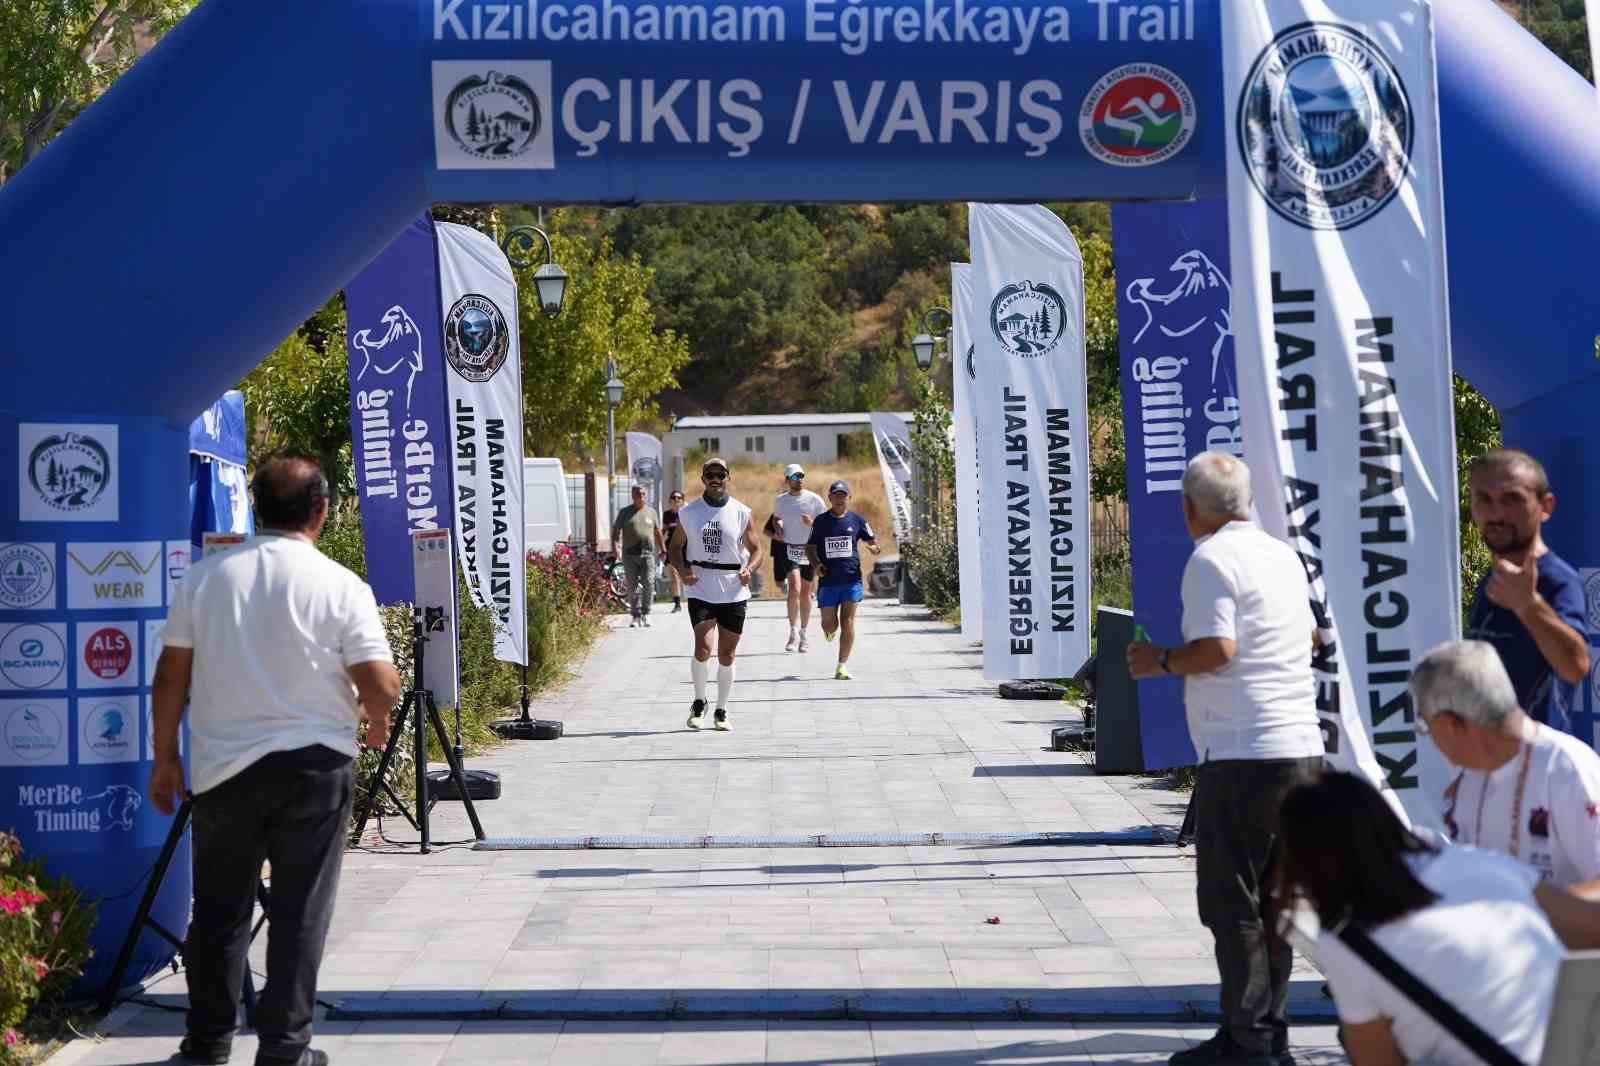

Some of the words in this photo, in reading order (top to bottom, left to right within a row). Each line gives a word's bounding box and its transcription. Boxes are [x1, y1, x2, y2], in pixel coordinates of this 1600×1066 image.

[432, 0, 786, 41] Kızılcahamam
[805, 0, 1070, 55] Eğrekkaya
[1088, 0, 1195, 41] Trail
[561, 77, 764, 157] ÇIKIŞ
[833, 79, 1063, 157] VARIŞ
[702, 536, 722, 545] NEVER
[704, 544, 720, 554] ENDS
[94, 582, 144, 599] WEAR
[92, 634, 125, 650] ALS
[18, 784, 82, 806] MerBe
[35, 808, 101, 833] Timing
